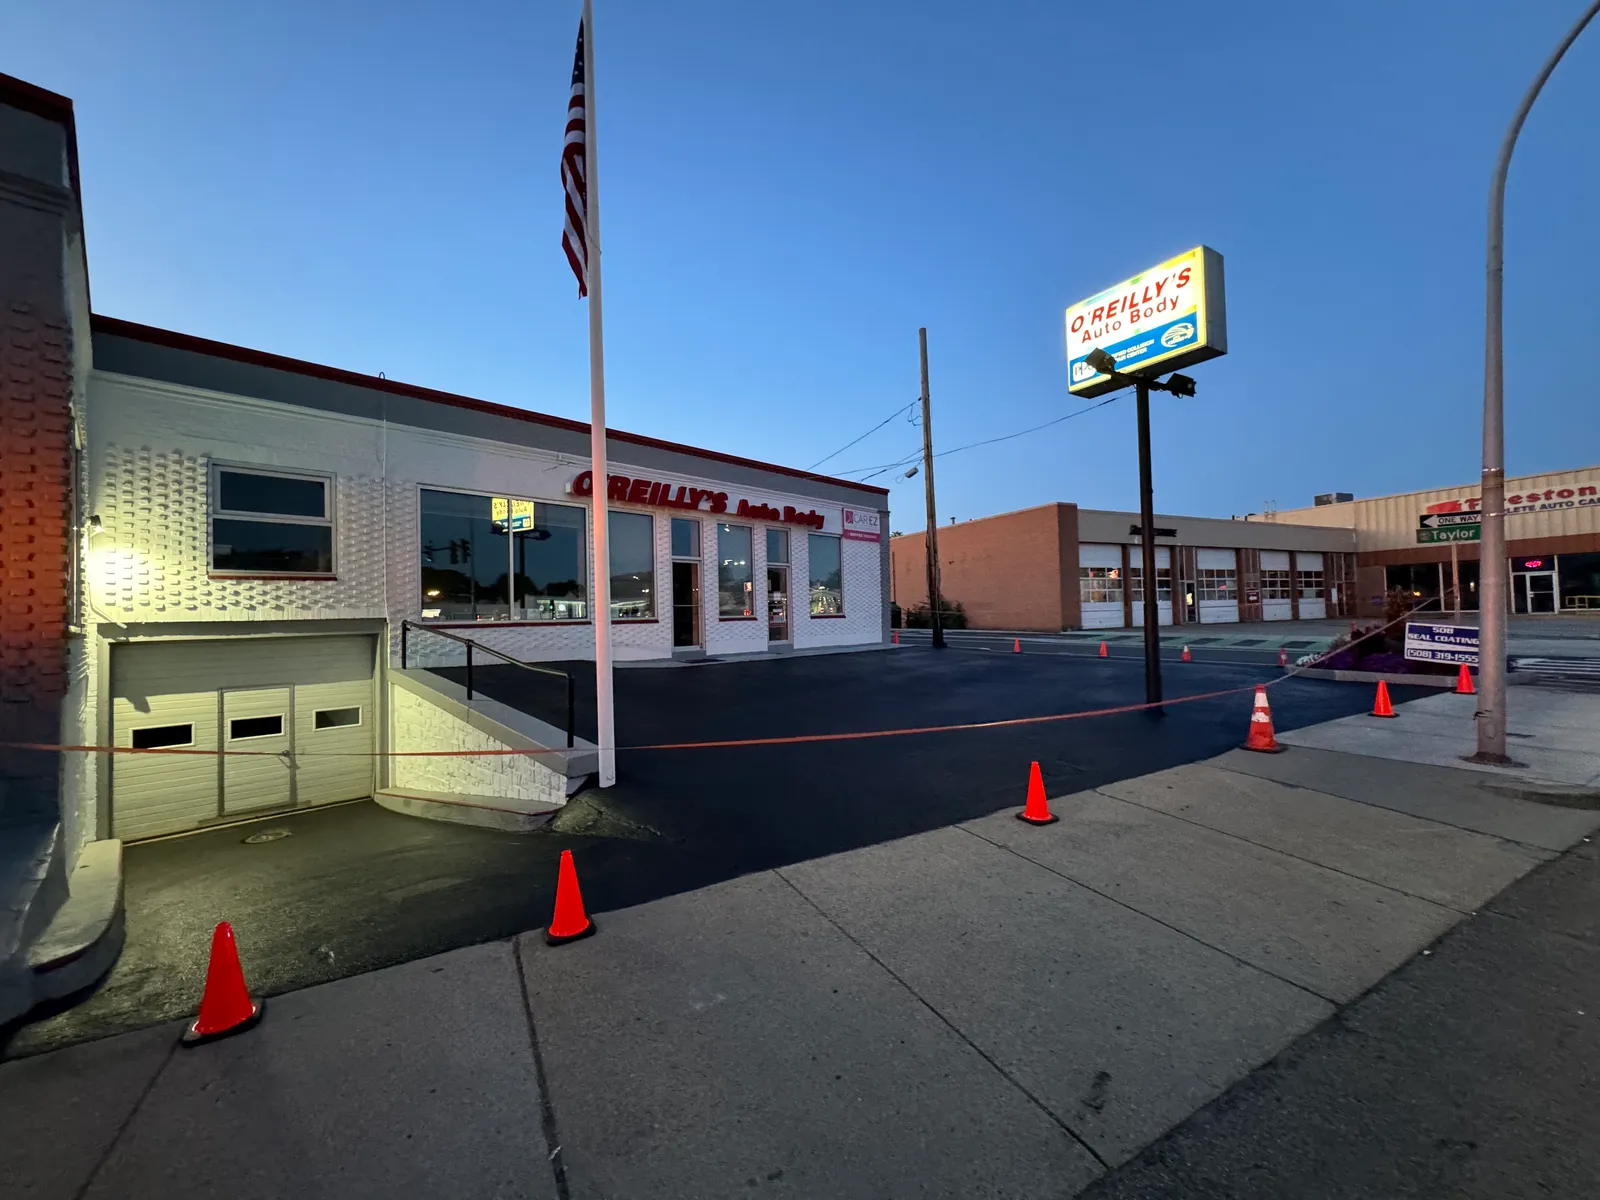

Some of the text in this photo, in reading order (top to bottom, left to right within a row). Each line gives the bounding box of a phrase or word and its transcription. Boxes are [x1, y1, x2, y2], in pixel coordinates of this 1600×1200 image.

[1071, 267, 1191, 333] O'REILLY'S
[1082, 295, 1179, 343] Auto Body
[1539, 500, 1574, 510] AUTO
[737, 499, 780, 521] Auto
[783, 506, 825, 530] Body
[1438, 514, 1479, 525] ONE WAY
[1431, 528, 1476, 541] Taylor
[1432, 626, 1454, 634] 508
[1407, 632, 1479, 645] SEAL COATING
[1434, 651, 1479, 663] 319-1555
